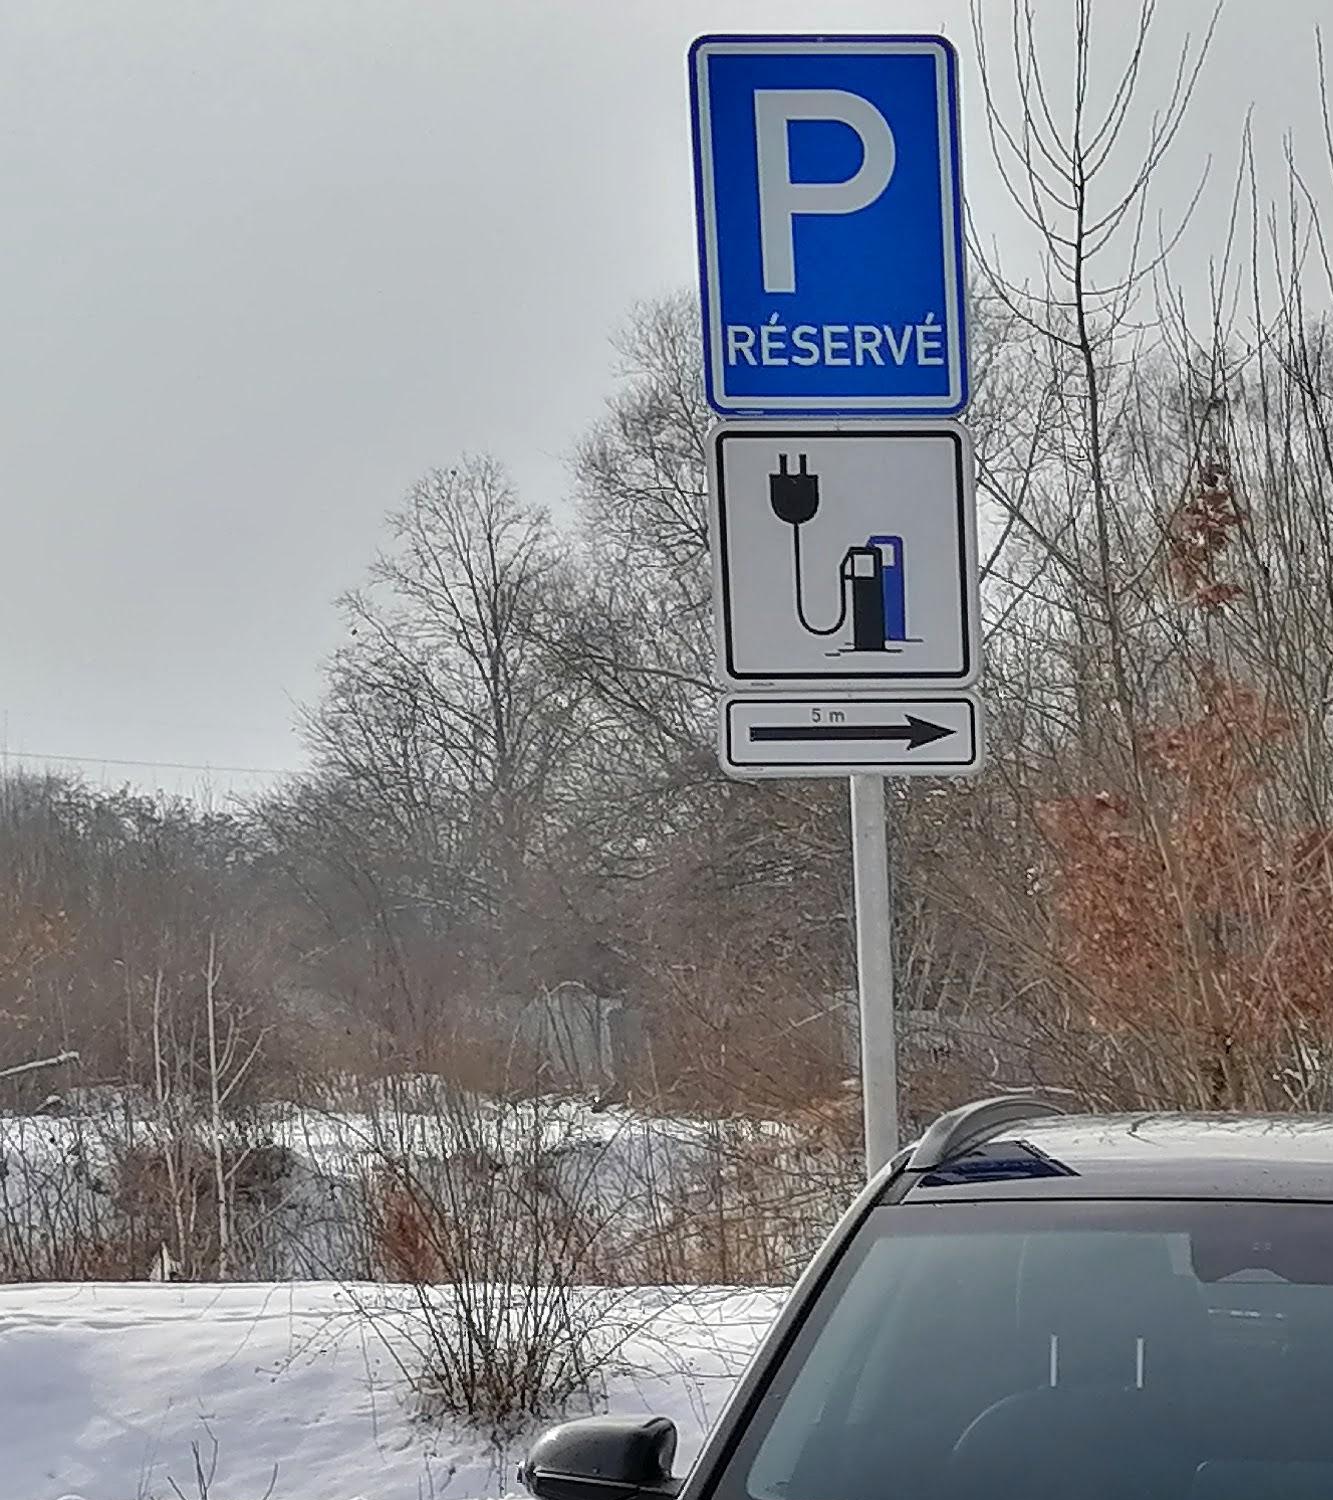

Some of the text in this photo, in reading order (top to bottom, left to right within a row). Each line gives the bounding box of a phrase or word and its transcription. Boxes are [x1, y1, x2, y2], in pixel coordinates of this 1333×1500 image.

[753, 88, 896, 294] P
[727, 312, 944, 368] RÉSERVÉ
[811, 707, 845, 723] 5 m
